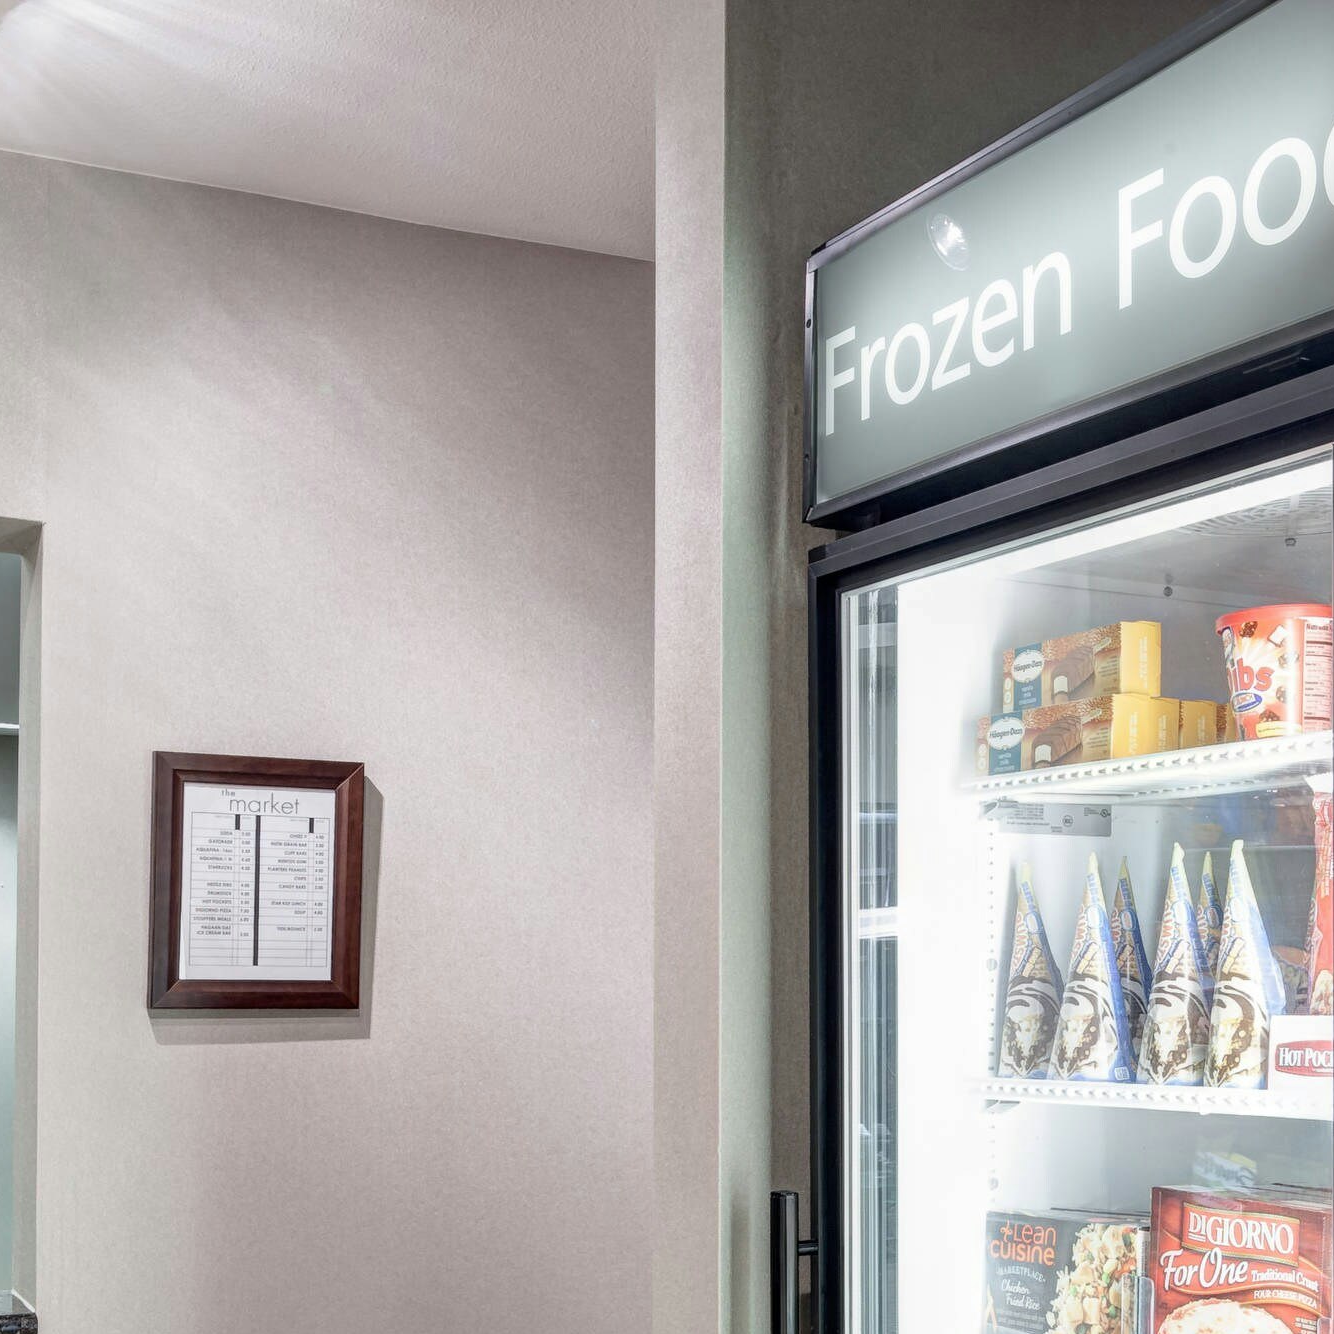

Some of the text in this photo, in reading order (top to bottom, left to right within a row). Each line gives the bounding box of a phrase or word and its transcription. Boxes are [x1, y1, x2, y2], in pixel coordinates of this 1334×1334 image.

[824, 251, 1072, 437] Frozen
[221, 789, 236, 797] the
[229, 792, 300, 815] market
[1278, 1047, 1302, 1066] HOT
[1013, 1223, 1057, 1246] Lean
[1160, 1249, 1198, 1291] For
[1199, 1247, 1250, 1288] One
[1251, 1268, 1295, 1283] Traditional
[1001, 1279, 1030, 1295] Chicken
[1253, 1289, 1271, 1299] FOUR
[1025, 1297, 1041, 1311] Rice
